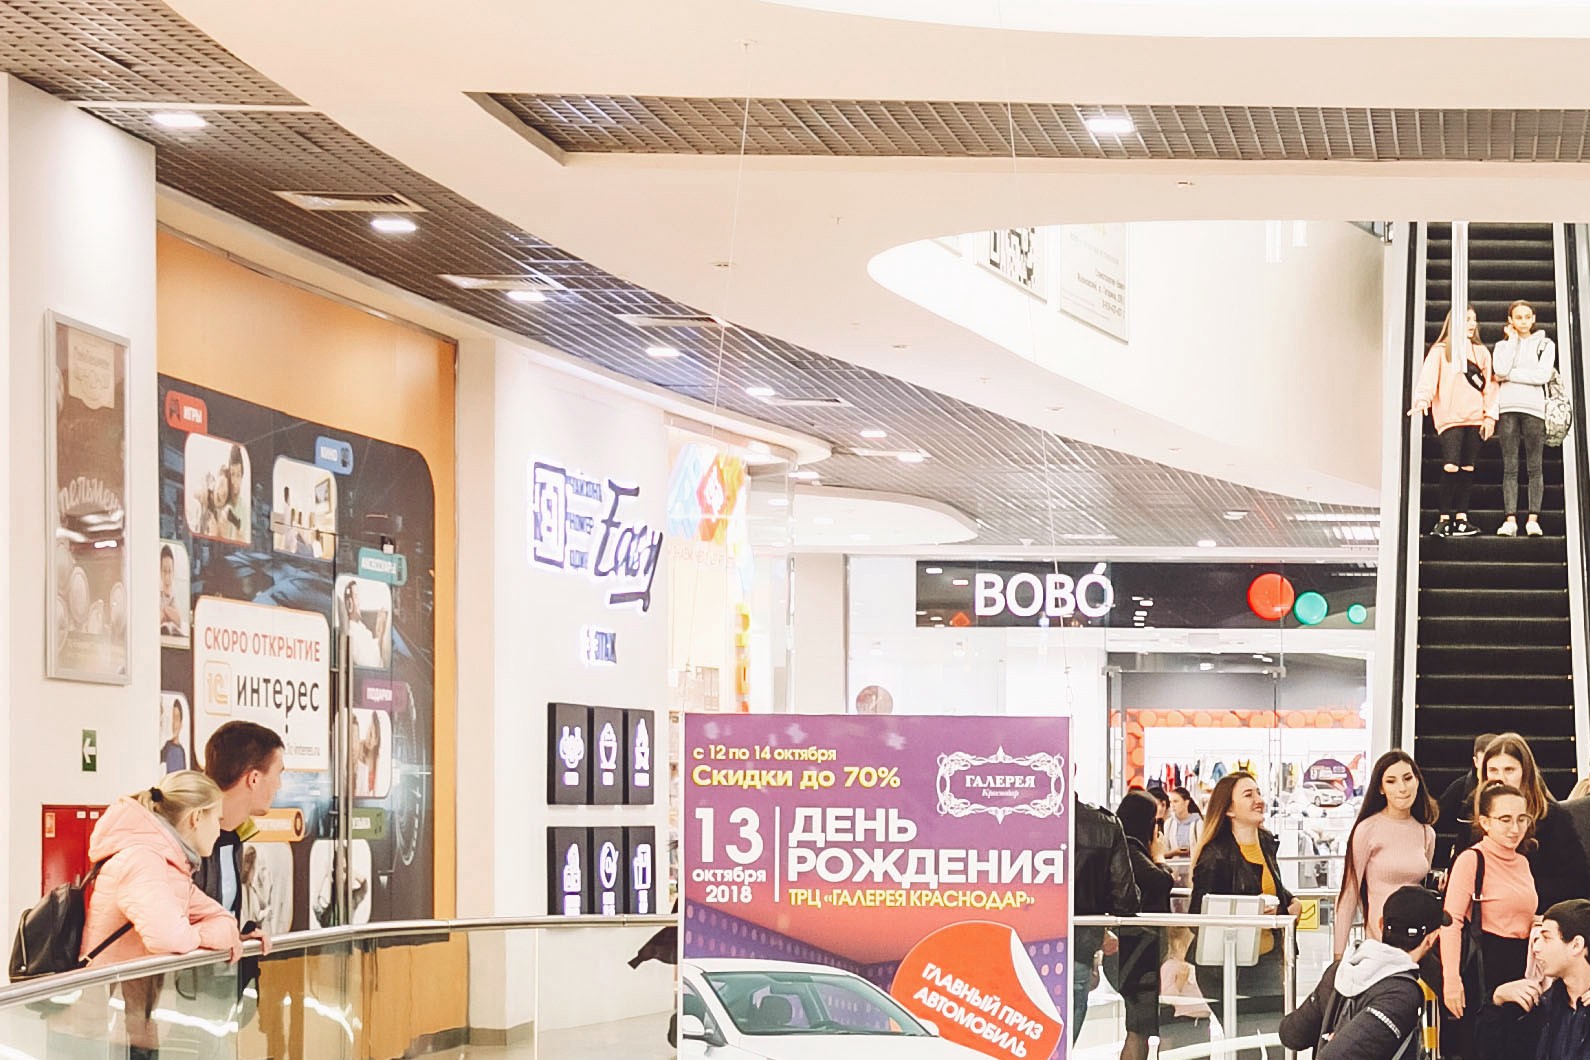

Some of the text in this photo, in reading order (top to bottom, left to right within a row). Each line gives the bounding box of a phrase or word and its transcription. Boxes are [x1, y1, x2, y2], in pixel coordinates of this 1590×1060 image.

[594, 479, 663, 612] Easy
[974, 562, 1115, 617] BOBÓ
[204, 627, 321, 662] СКОРО ОТКРЫТИЕ
[237, 675, 320, 733] интерес
[693, 745, 836, 763] с 12 по 14 октября
[692, 765, 901, 790] Скидки до 70%
[965, 775, 1036, 788] ГАЛЕРЕЯ
[695, 807, 764, 865] 13
[788, 807, 918, 848] ДЕНЬ
[692, 867, 766, 888] октября
[788, 846, 1065, 889] РОЖДЕНИЯ
[706, 886, 753, 904] 2018
[788, 889, 1035, 910] ТРЦ «ГАЛЕРЕЯ КРАСНОДАР»
[921, 963, 1044, 1040] ГЛАВНЫЙ ПРИЗ
[913, 987, 1027, 1059] АВТОМОБИЛЬ
